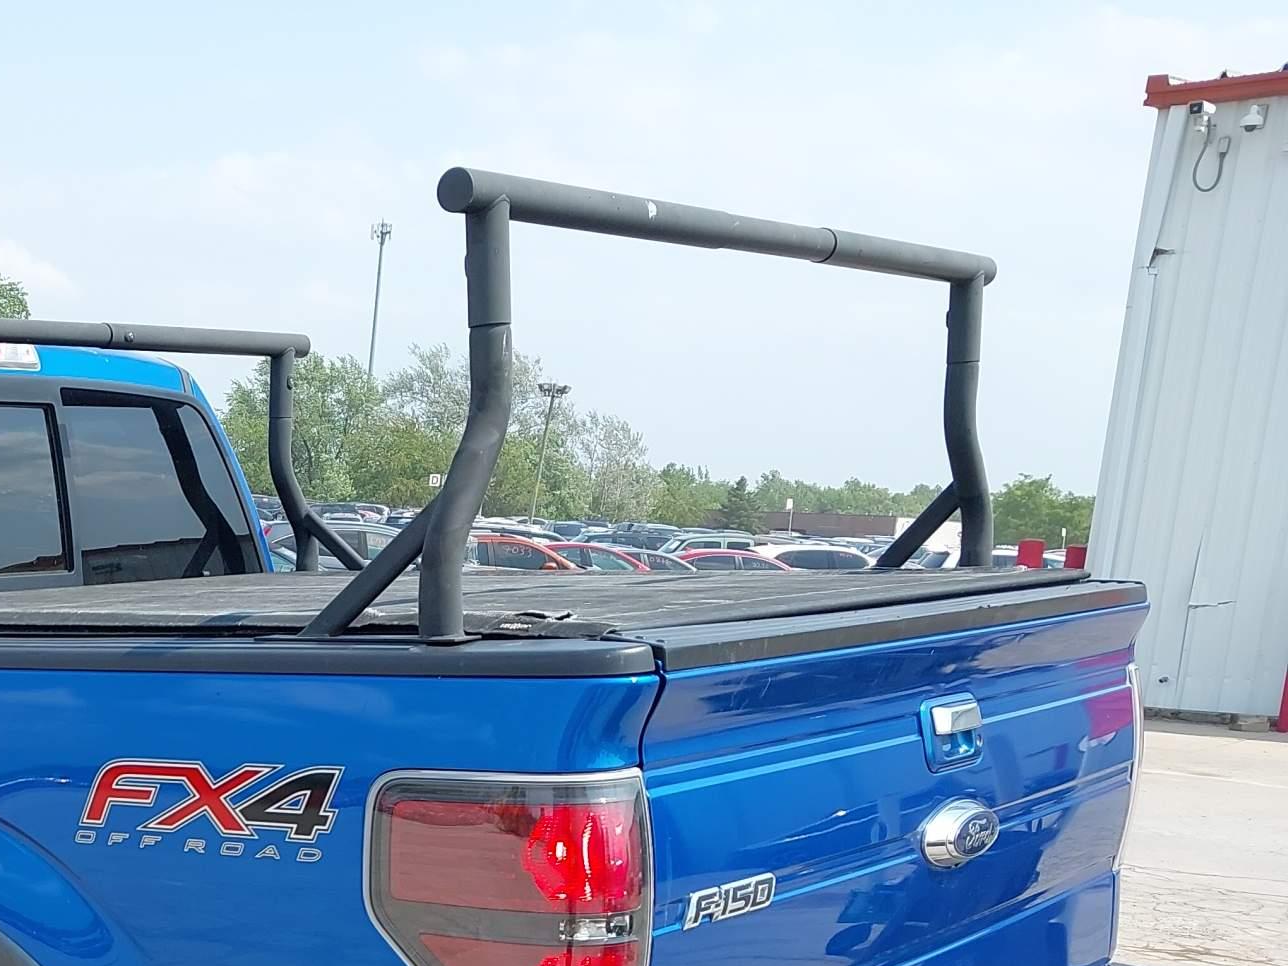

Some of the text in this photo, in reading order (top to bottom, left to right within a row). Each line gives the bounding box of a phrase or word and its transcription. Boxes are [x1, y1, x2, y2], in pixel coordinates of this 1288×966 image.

[79, 758, 345, 844] FX4
[74, 830, 323, 863] OFF ROAD
[964, 818, 995, 850] Ford
[683, 872, 776, 931] F-150
